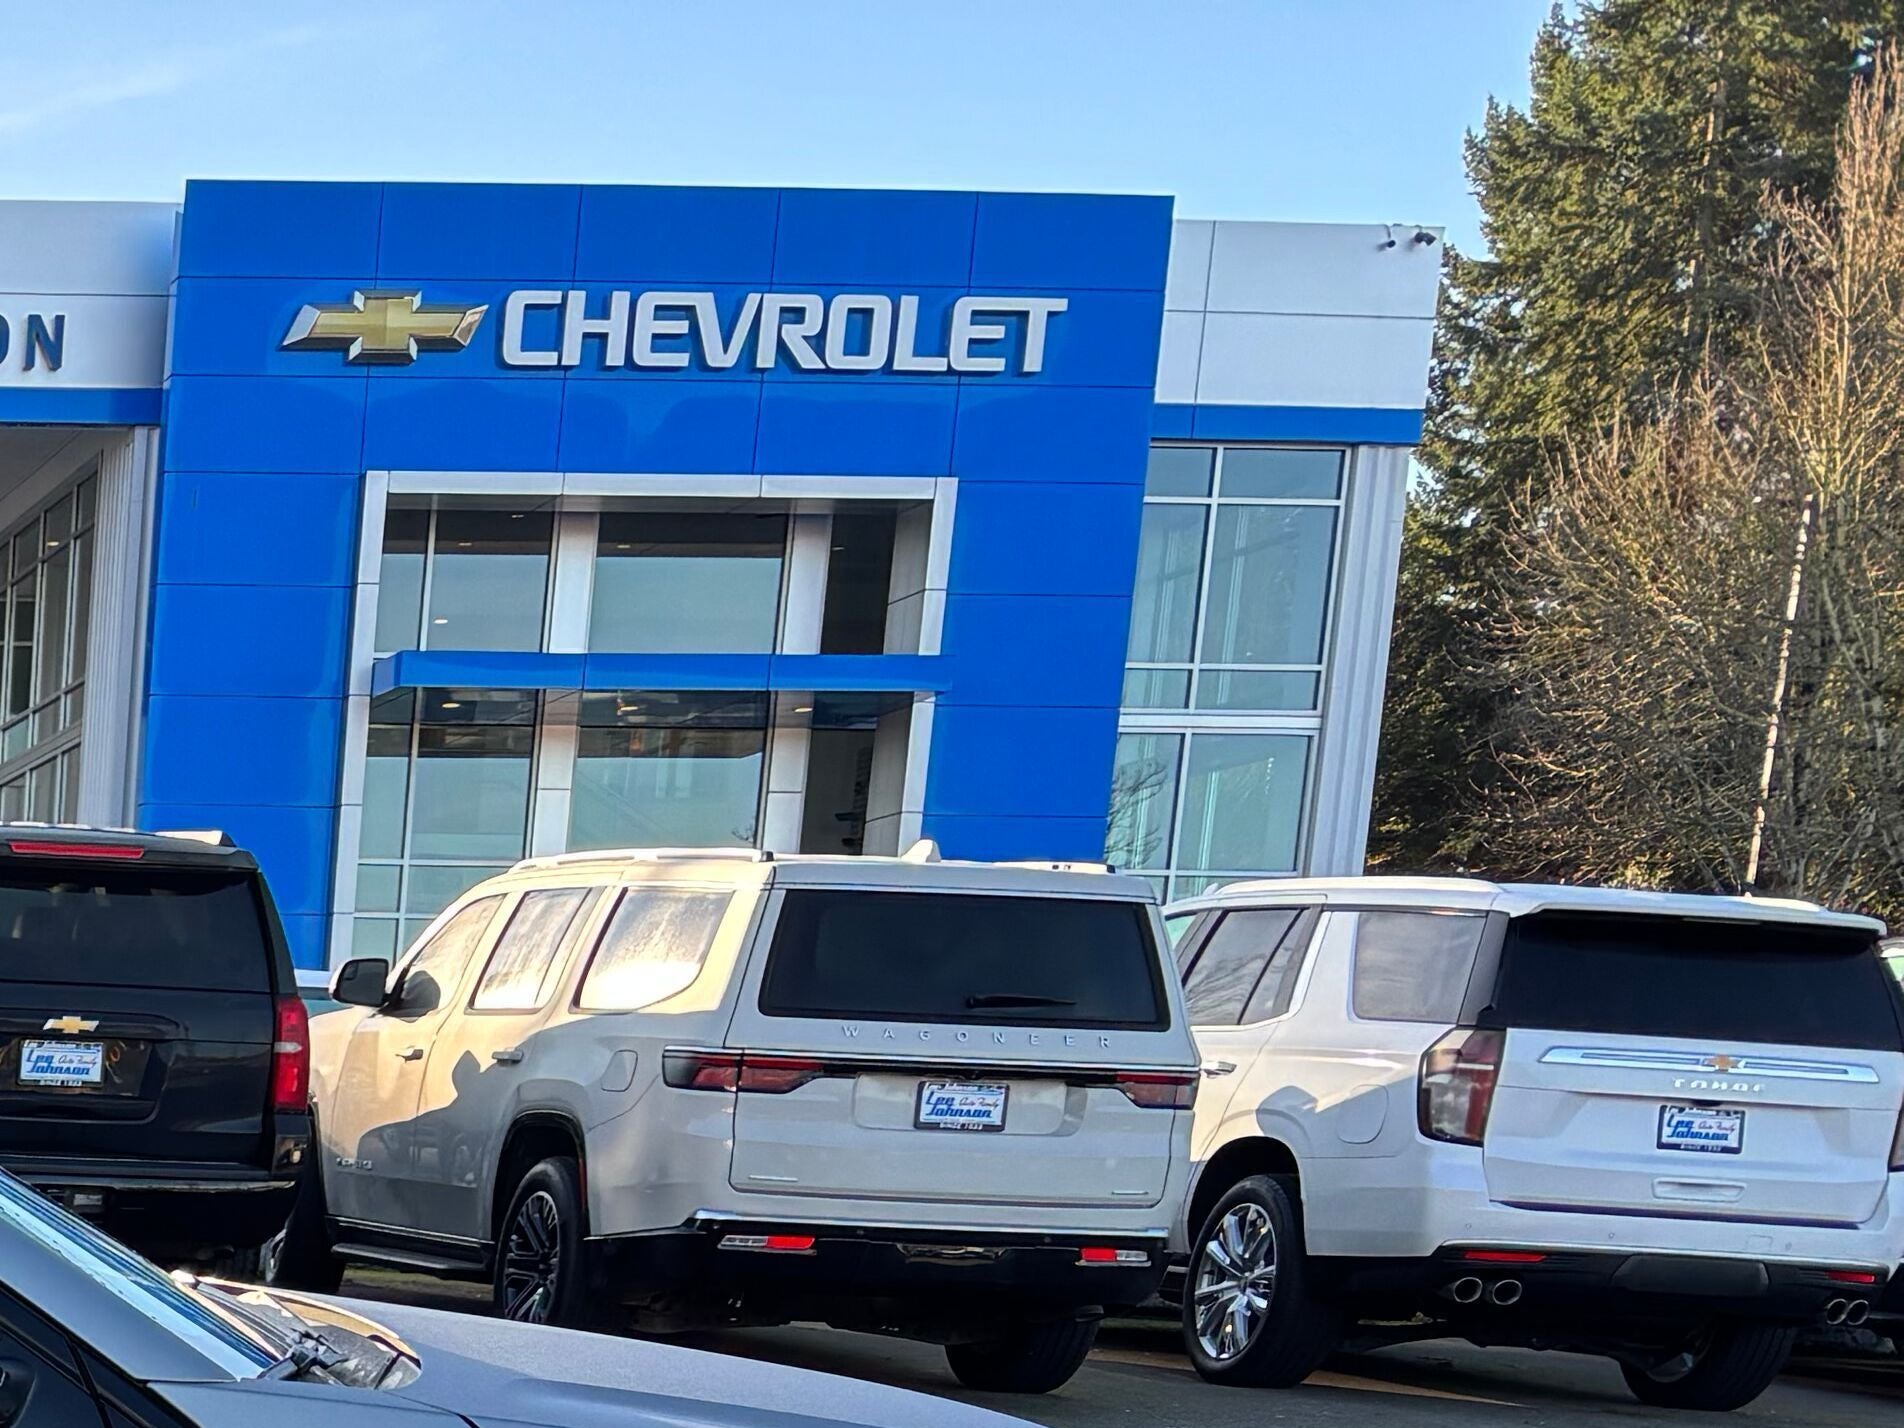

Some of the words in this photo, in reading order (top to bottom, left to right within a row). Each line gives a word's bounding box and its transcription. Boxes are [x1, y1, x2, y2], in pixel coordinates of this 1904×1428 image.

[501, 290, 1069, 373] CHEVROLET
[842, 1024, 1111, 1049] WAGONEER
[925, 1091, 955, 1107] Lee
[925, 1104, 993, 1118] Johnson
